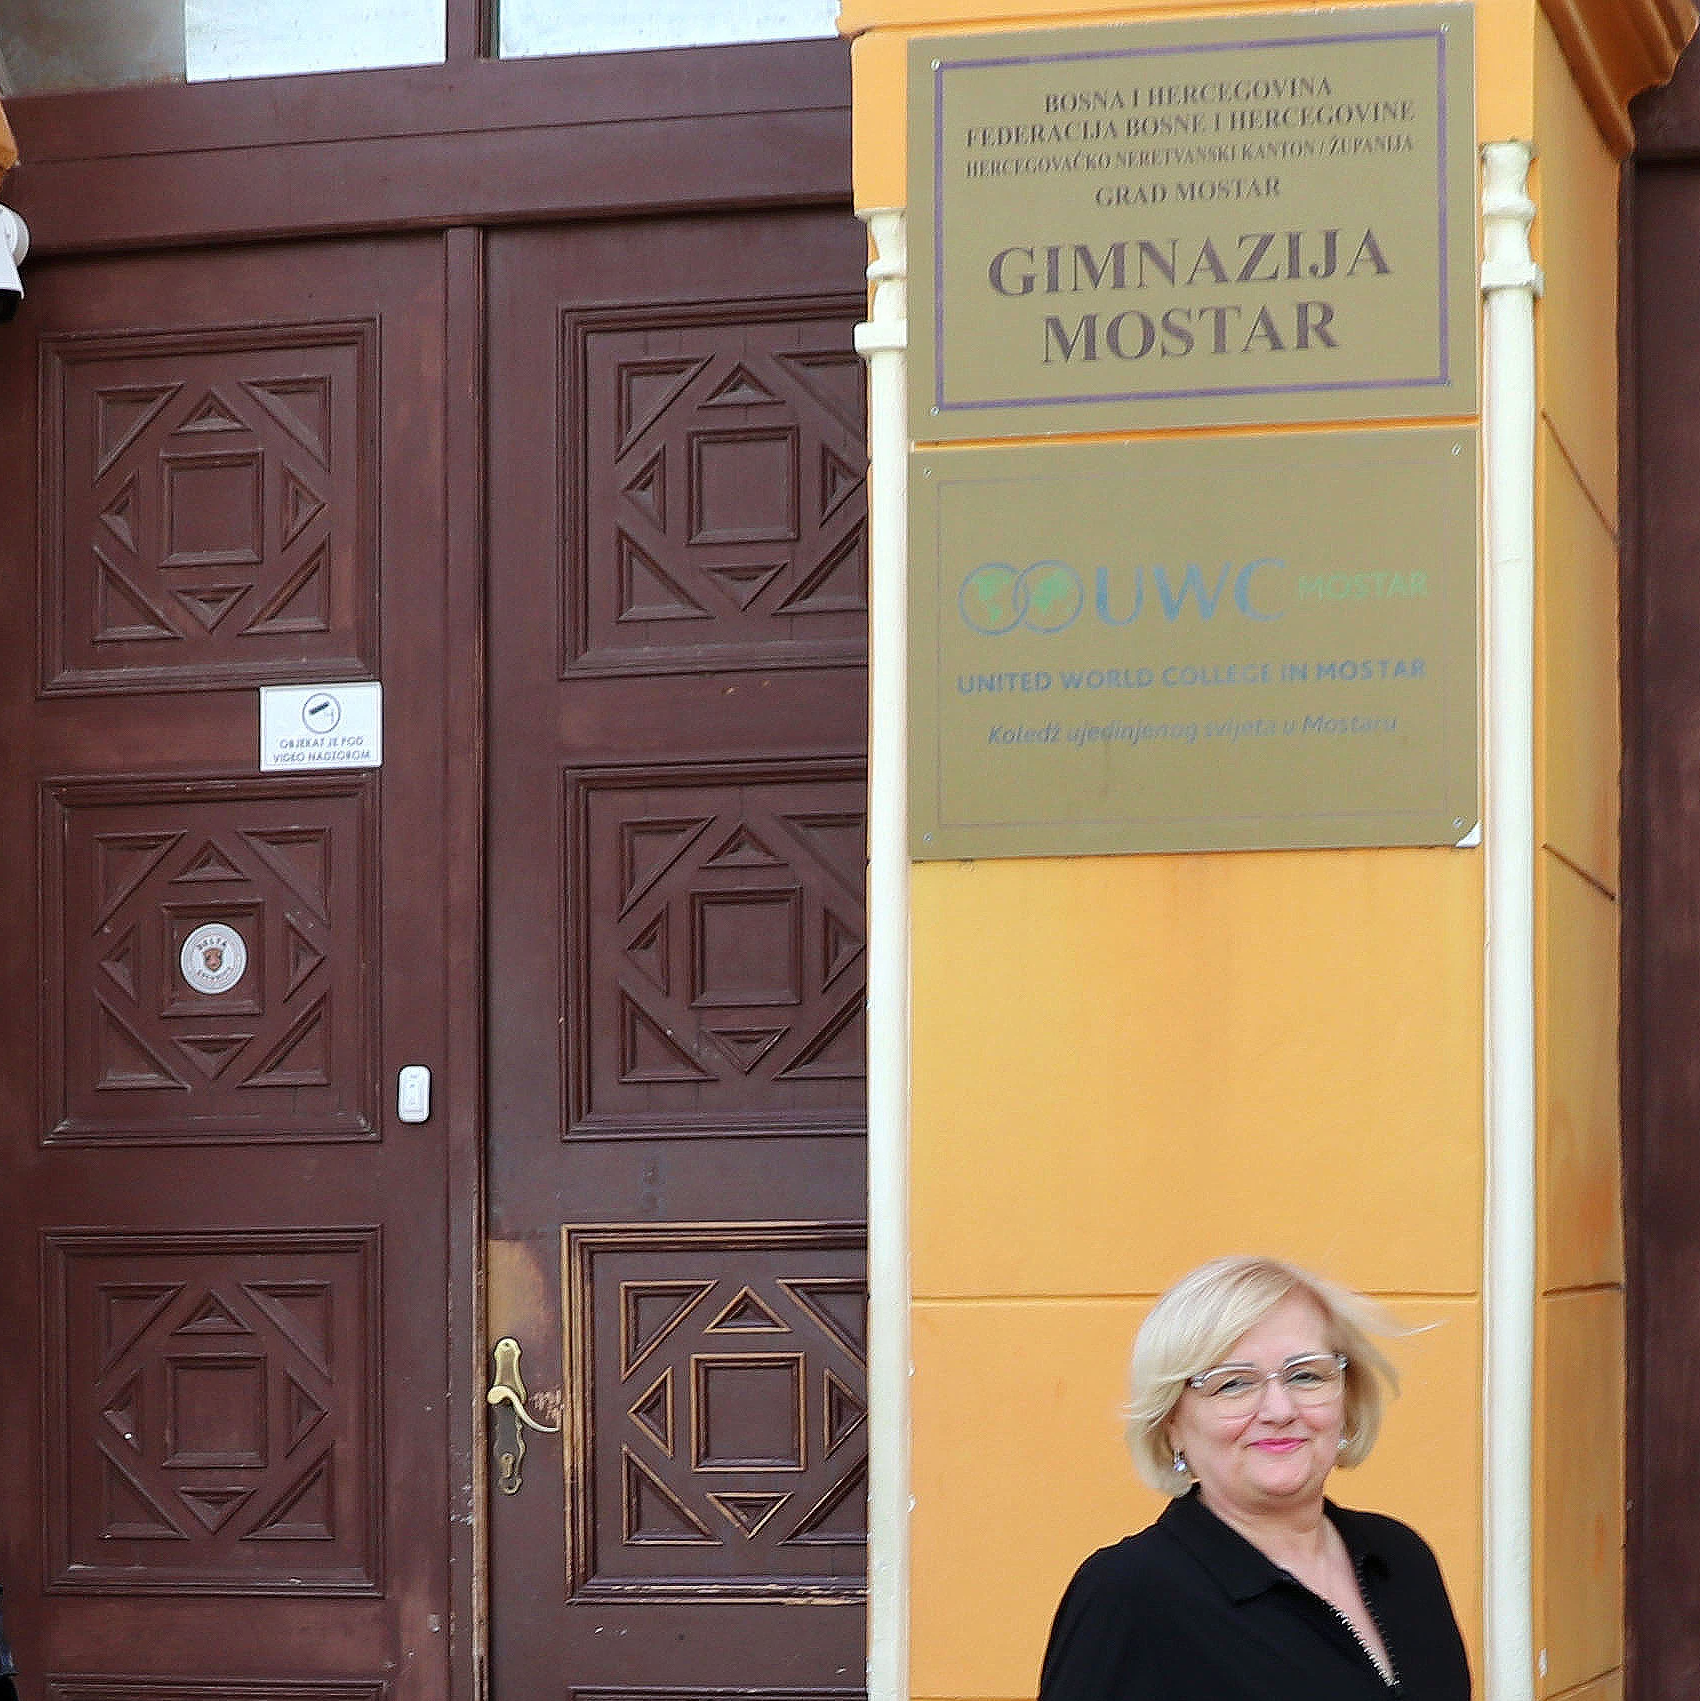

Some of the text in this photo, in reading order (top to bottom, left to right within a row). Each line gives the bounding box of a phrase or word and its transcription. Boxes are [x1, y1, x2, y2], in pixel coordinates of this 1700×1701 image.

[1045, 76, 1333, 113] BOSNA I HERCEGOVINA
[966, 101, 1416, 148] FEDERACIJA BOSNE I HERCEGOVINE
[1095, 175, 1282, 207] GRAD MOSTAR
[988, 228, 1393, 298] GIMNAZIJA
[1041, 300, 1342, 367] MOSTAR
[1094, 557, 1430, 627] UWC MOSTAR
[957, 656, 1427, 696] UNITED WORLD COLLEGE IN MOSTAR
